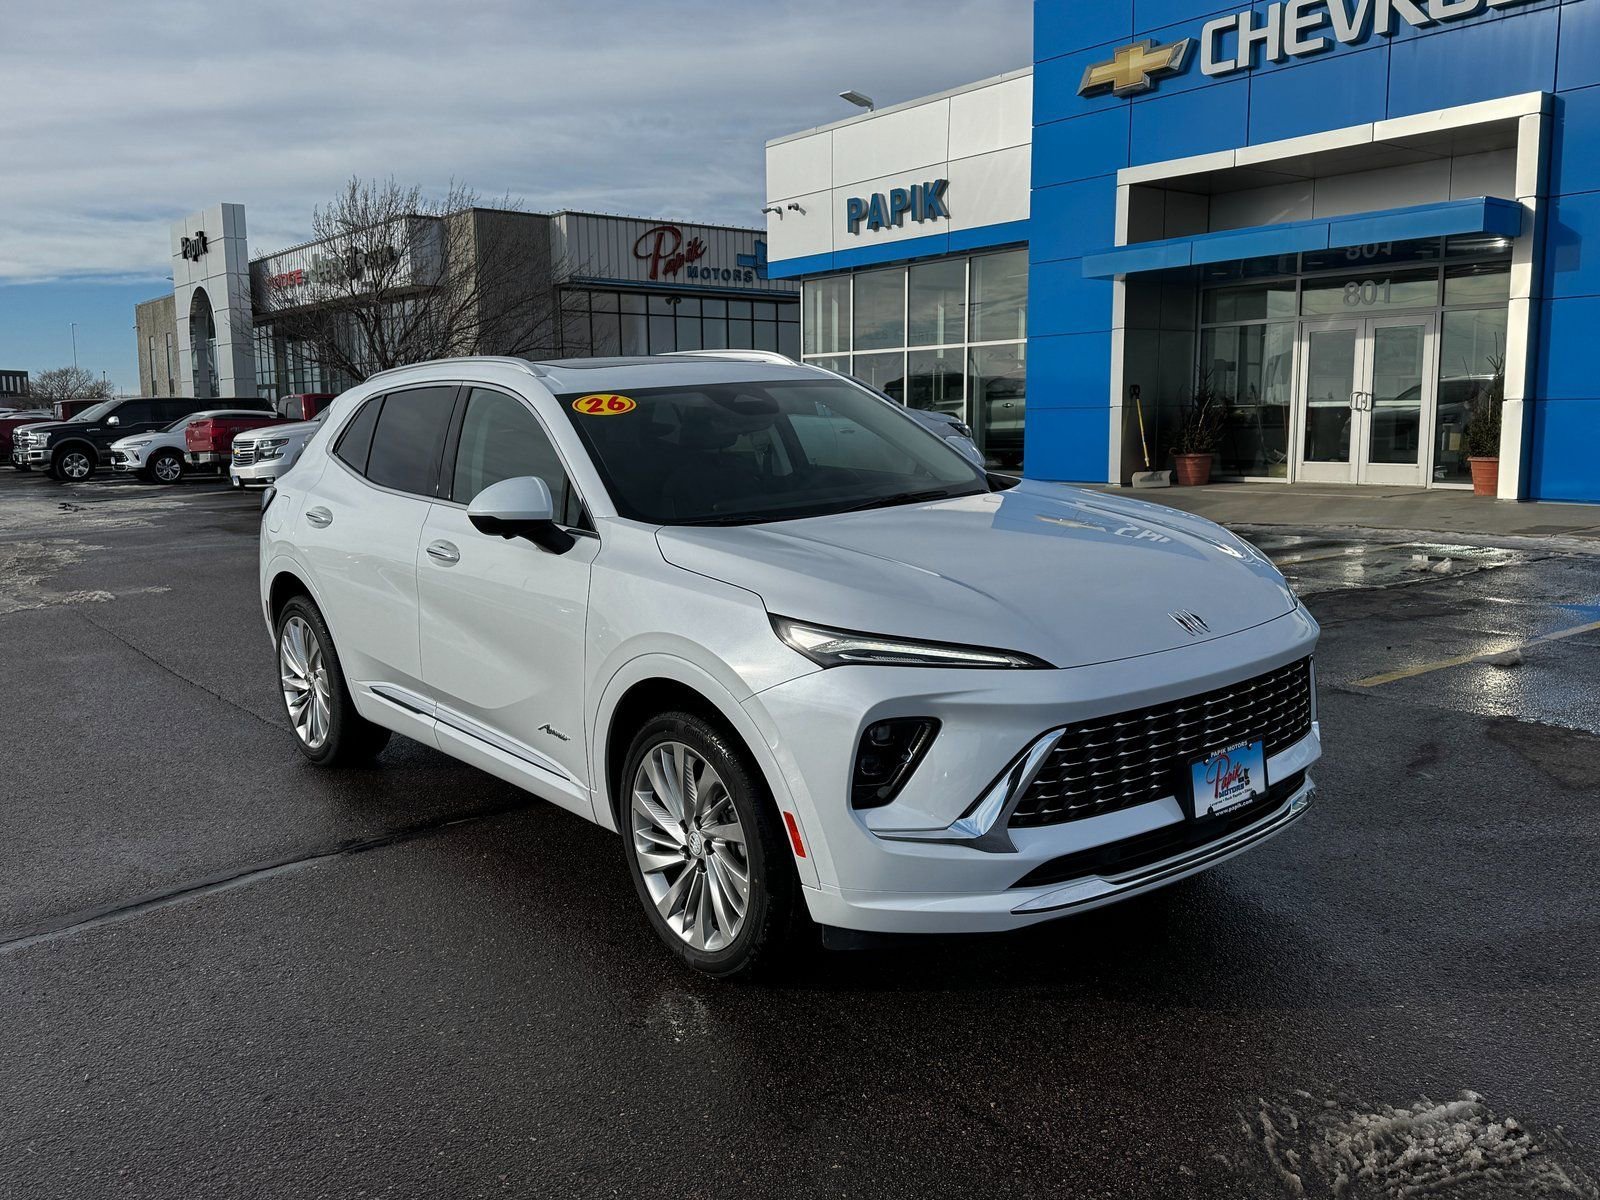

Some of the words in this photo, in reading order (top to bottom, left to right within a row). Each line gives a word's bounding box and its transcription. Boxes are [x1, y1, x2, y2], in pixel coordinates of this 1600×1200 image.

[1201, 0, 1513, 76] CHEVR
[846, 179, 951, 236] PAPIK
[633, 225, 707, 280] Papik
[687, 266, 753, 283] MOTORS
[1343, 279, 1391, 306] 801
[585, 396, 626, 413] 26
[1210, 747, 1227, 758] PAPIK
[1227, 740, 1248, 753] MOTORS
[1219, 783, 1245, 798] MOTORS
